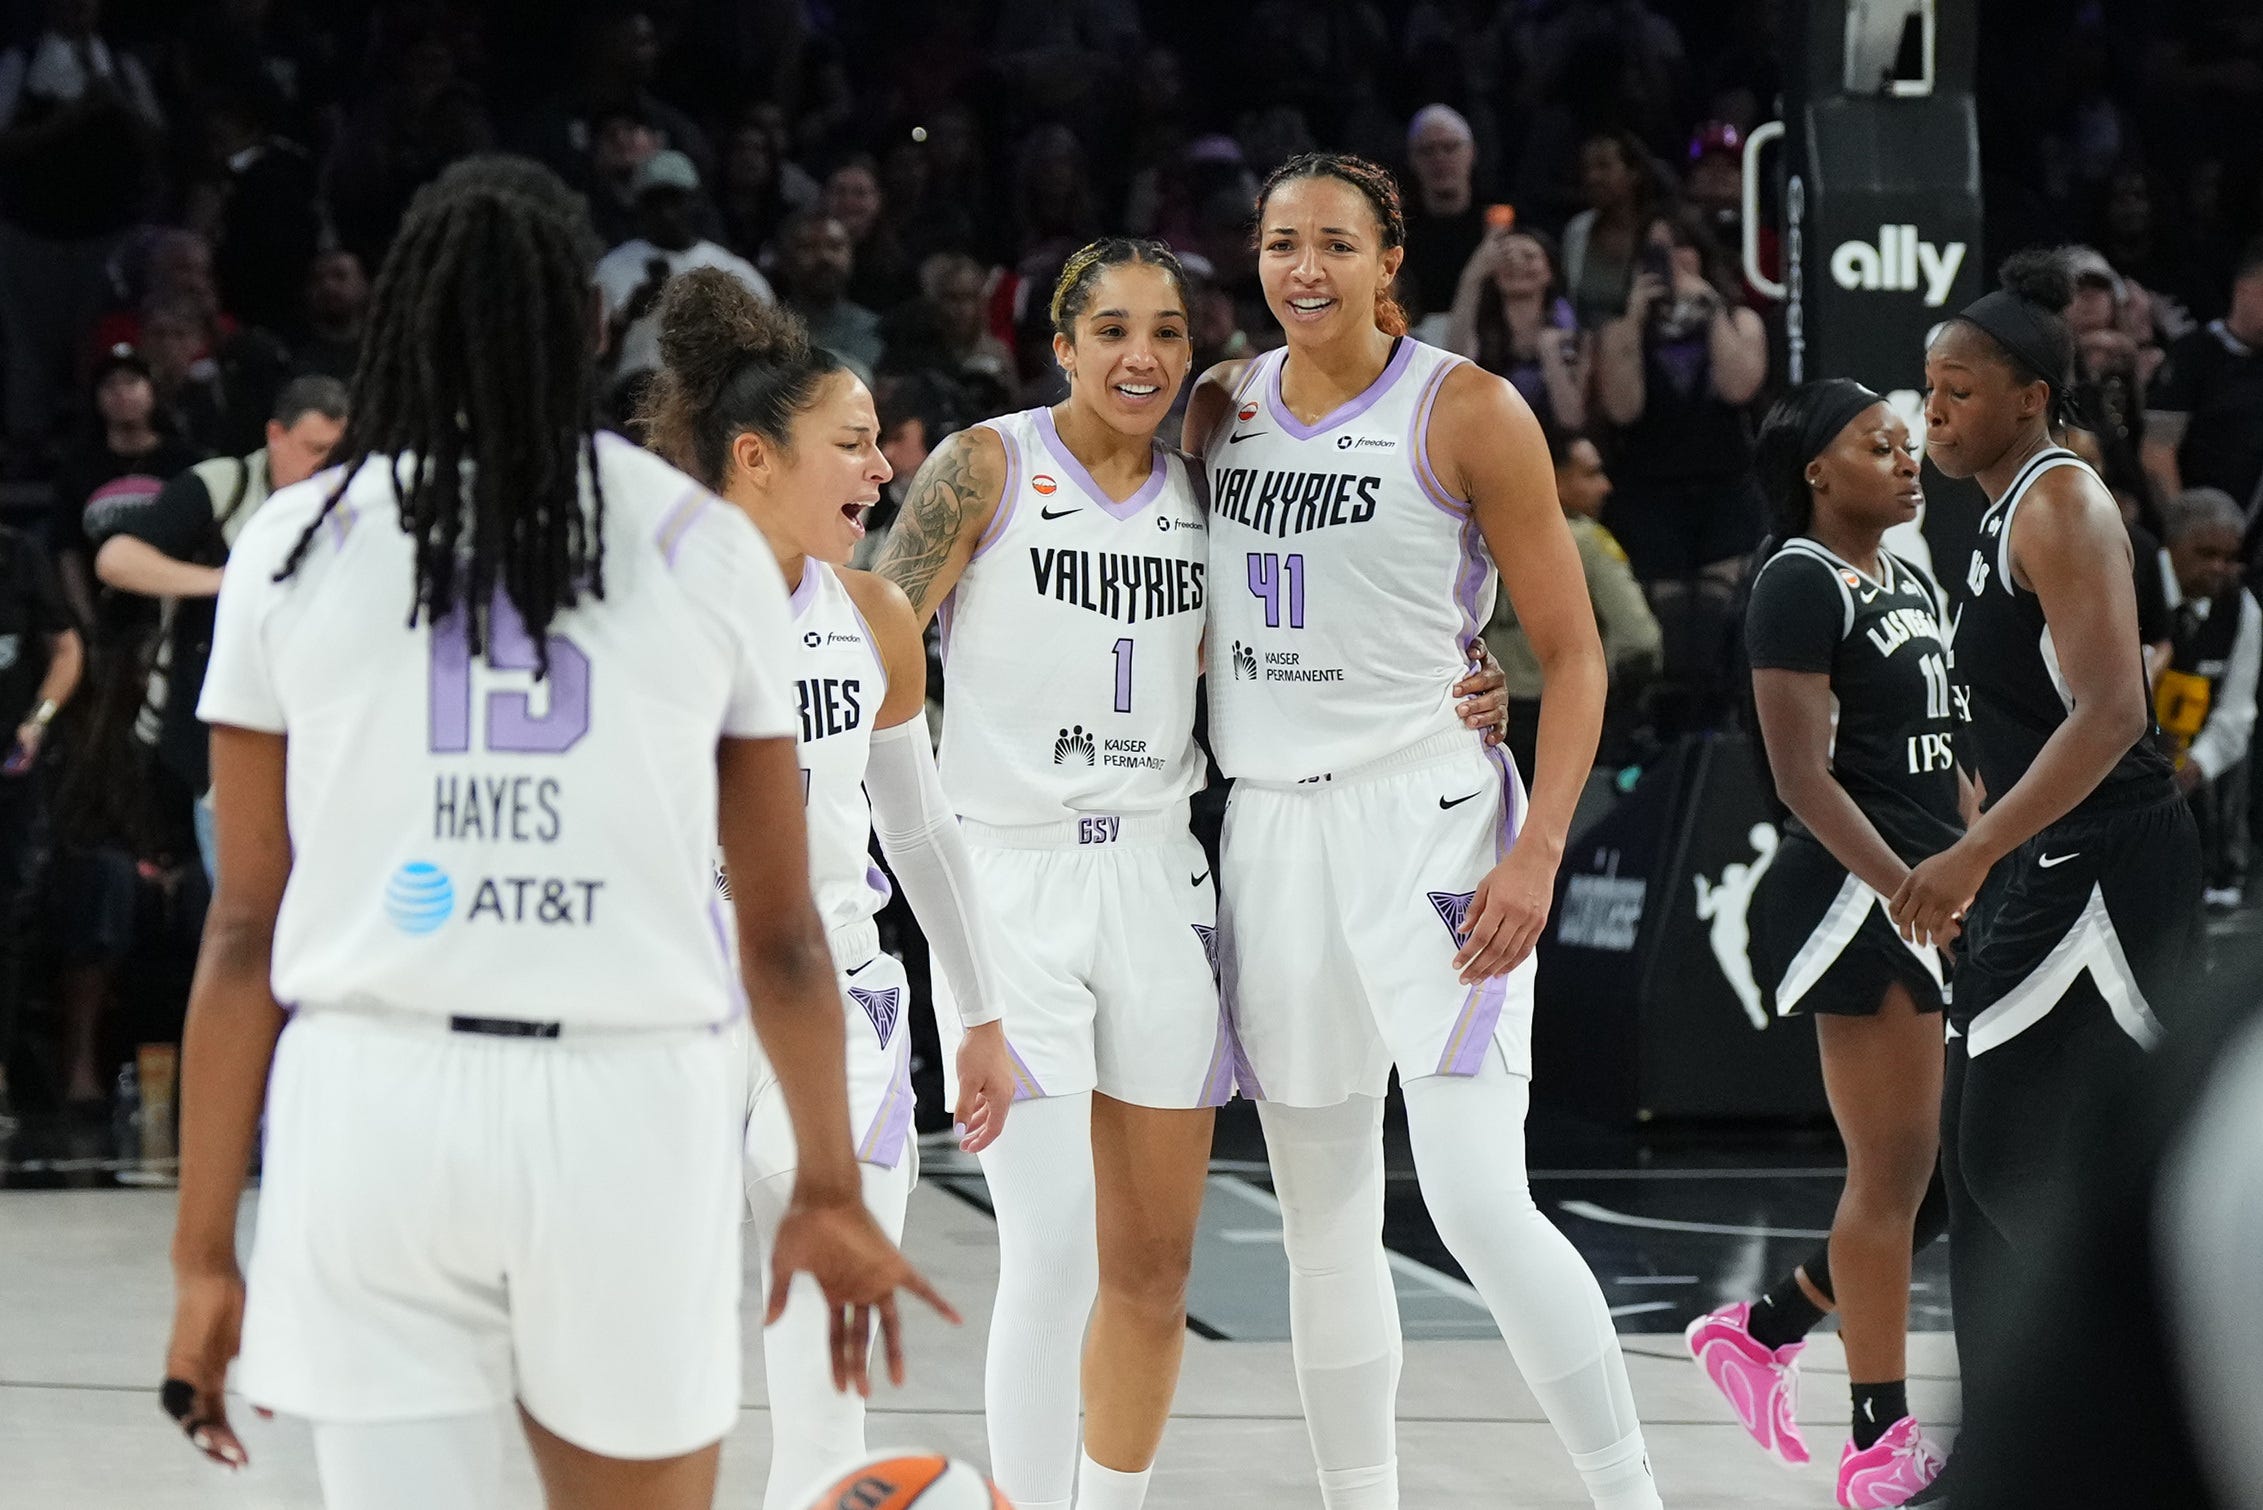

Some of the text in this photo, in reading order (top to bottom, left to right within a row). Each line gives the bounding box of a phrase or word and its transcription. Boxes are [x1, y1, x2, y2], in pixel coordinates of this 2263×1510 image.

[1830, 224, 1967, 307] ally
[1354, 436, 1396, 449] freedom
[1215, 468, 1382, 539] VALKYRIES
[1029, 547, 1205, 625] VALKYRIES
[1246, 552, 1305, 629] 41
[1866, 610, 1911, 658] LAS
[1111, 638, 1134, 714] 1
[1265, 652, 1300, 665] KAISER
[1266, 668, 1345, 682] PERMANENTE
[1918, 652, 1951, 719] 11
[1104, 739, 1147, 753] KAISER
[1908, 732, 1953, 774] IPS
[433, 774, 561, 843] HAYES
[1078, 816, 1120, 845] GSV
[466, 876, 606, 924] AT&T
